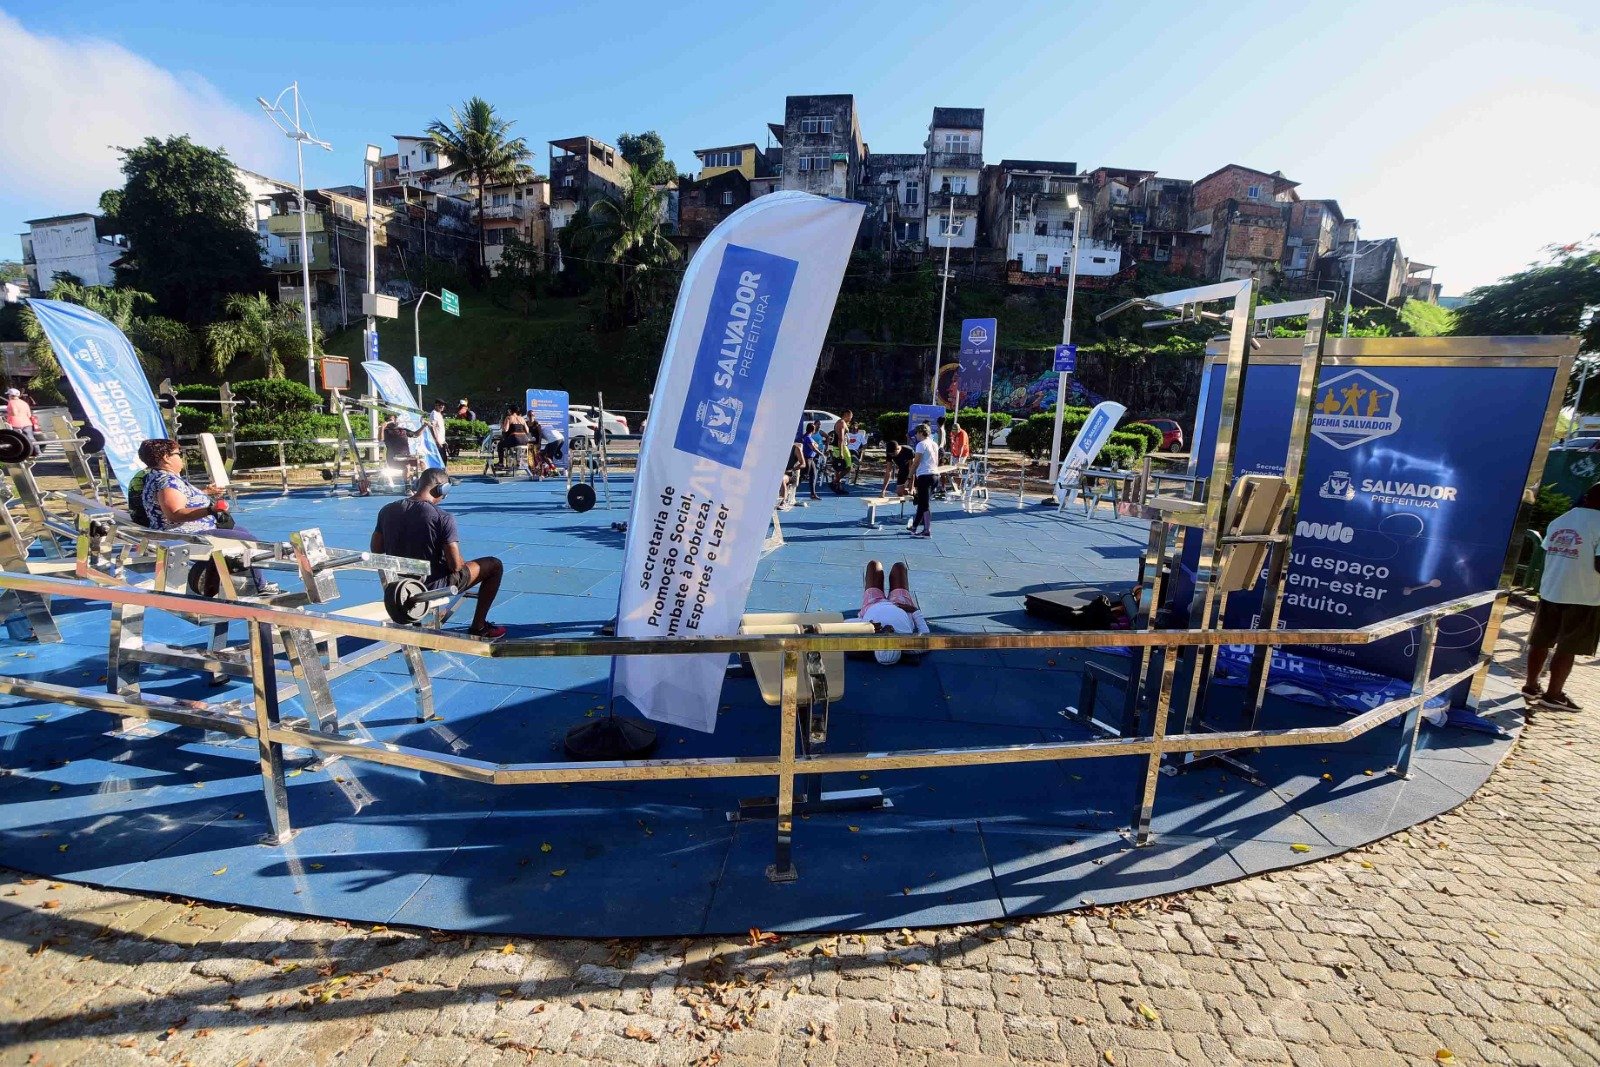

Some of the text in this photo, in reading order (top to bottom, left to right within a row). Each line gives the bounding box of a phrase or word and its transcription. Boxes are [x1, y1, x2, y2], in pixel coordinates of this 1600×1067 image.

[714, 270, 761, 389] SALVADOR
[739, 294, 771, 378] PREFEITURA
[1312, 417, 1392, 431] ADEMIA SALVADOR
[1256, 463, 1284, 471] Secreta
[1361, 478, 1458, 501] SALVADOR
[1371, 494, 1439, 509] PREFEITURA
[640, 486, 675, 590] Secretaria de
[684, 499, 714, 566] Pobreza,
[647, 493, 695, 627] Promoção Social,
[687, 503, 729, 630] Esportes e Lazer
[1311, 556, 1390, 580] espaço
[679, 570, 693, 580] à
[1285, 572, 1387, 601] em-estar
[1283, 592, 1353, 616] ratuito.
